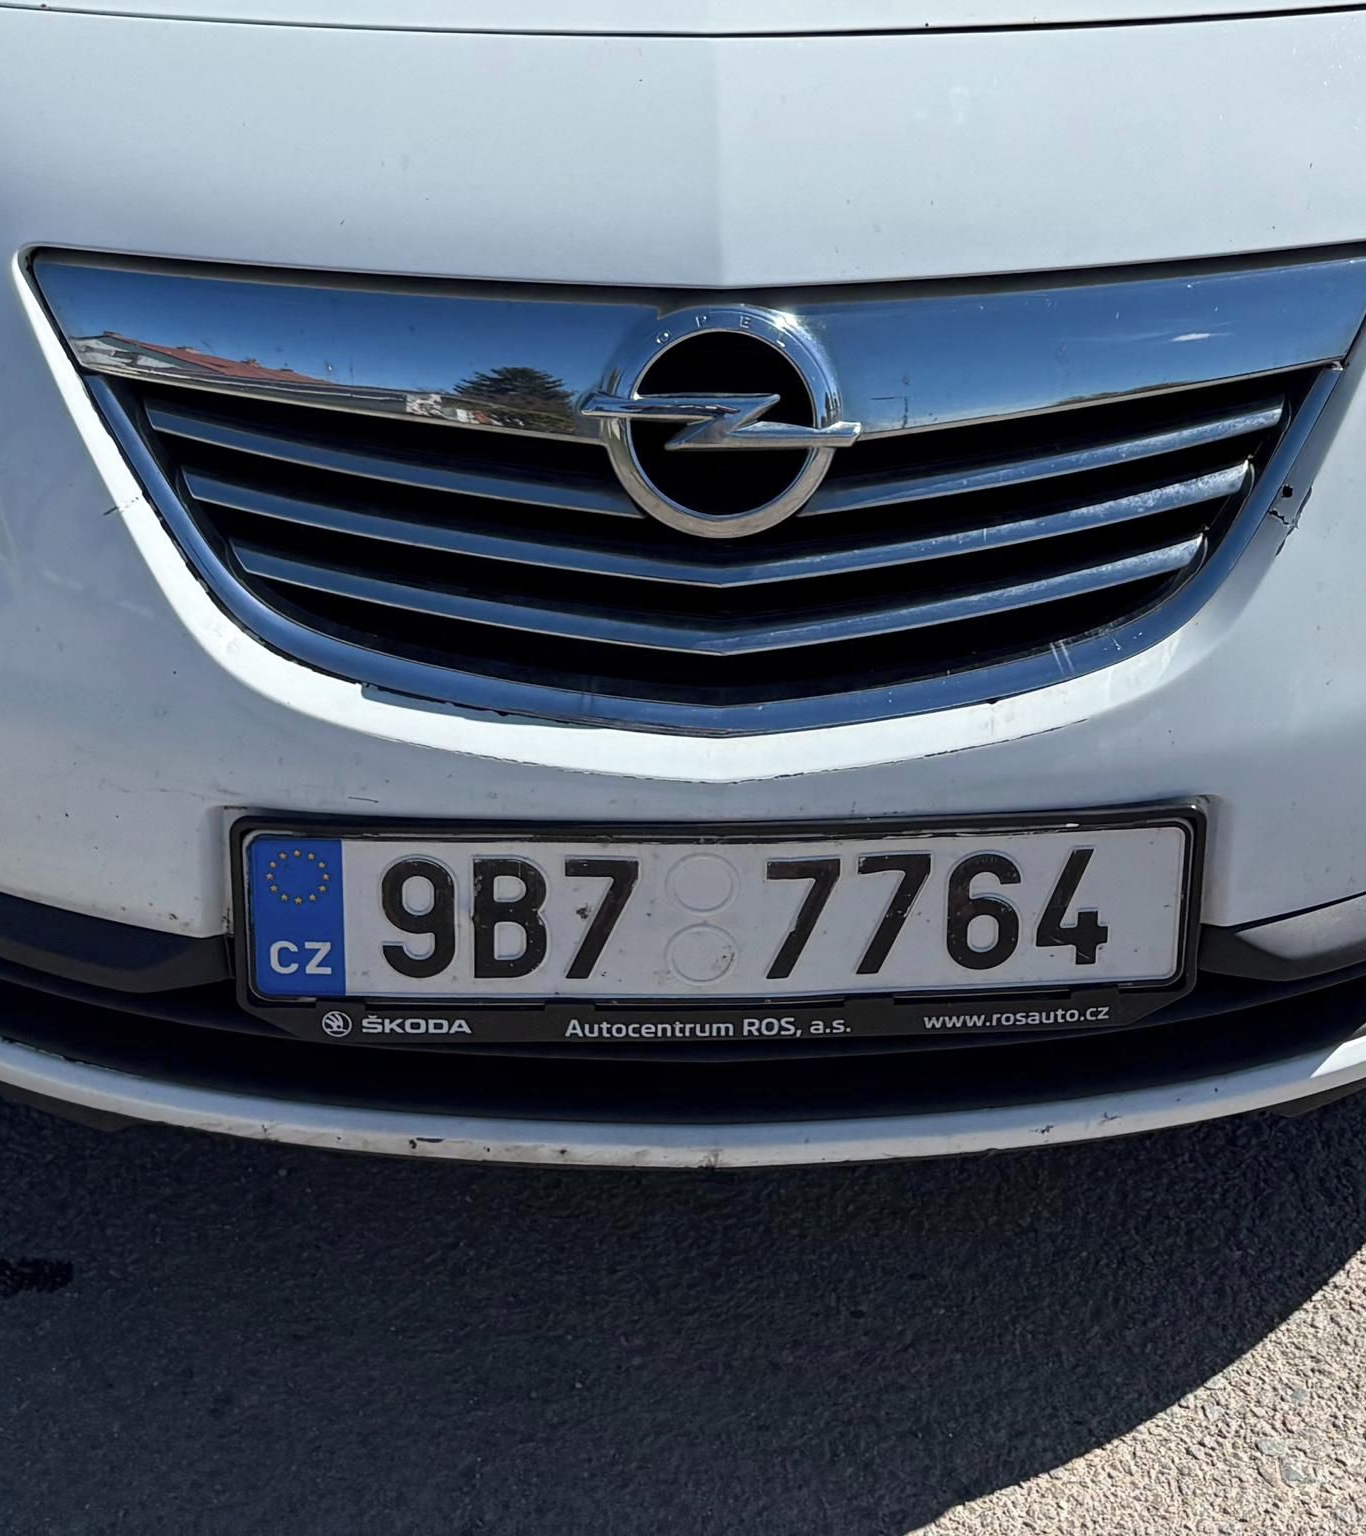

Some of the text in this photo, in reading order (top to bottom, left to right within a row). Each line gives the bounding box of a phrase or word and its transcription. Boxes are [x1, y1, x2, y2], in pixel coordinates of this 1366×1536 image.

[381, 848, 1109, 980] 9B7 7764
[269, 941, 332, 975] CZ
[362, 1015, 472, 1034] ŠKODA
[565, 1017, 852, 1038] Autocentrum ROS, a.s.
[924, 1006, 1110, 1029] www.rosauto.cz
